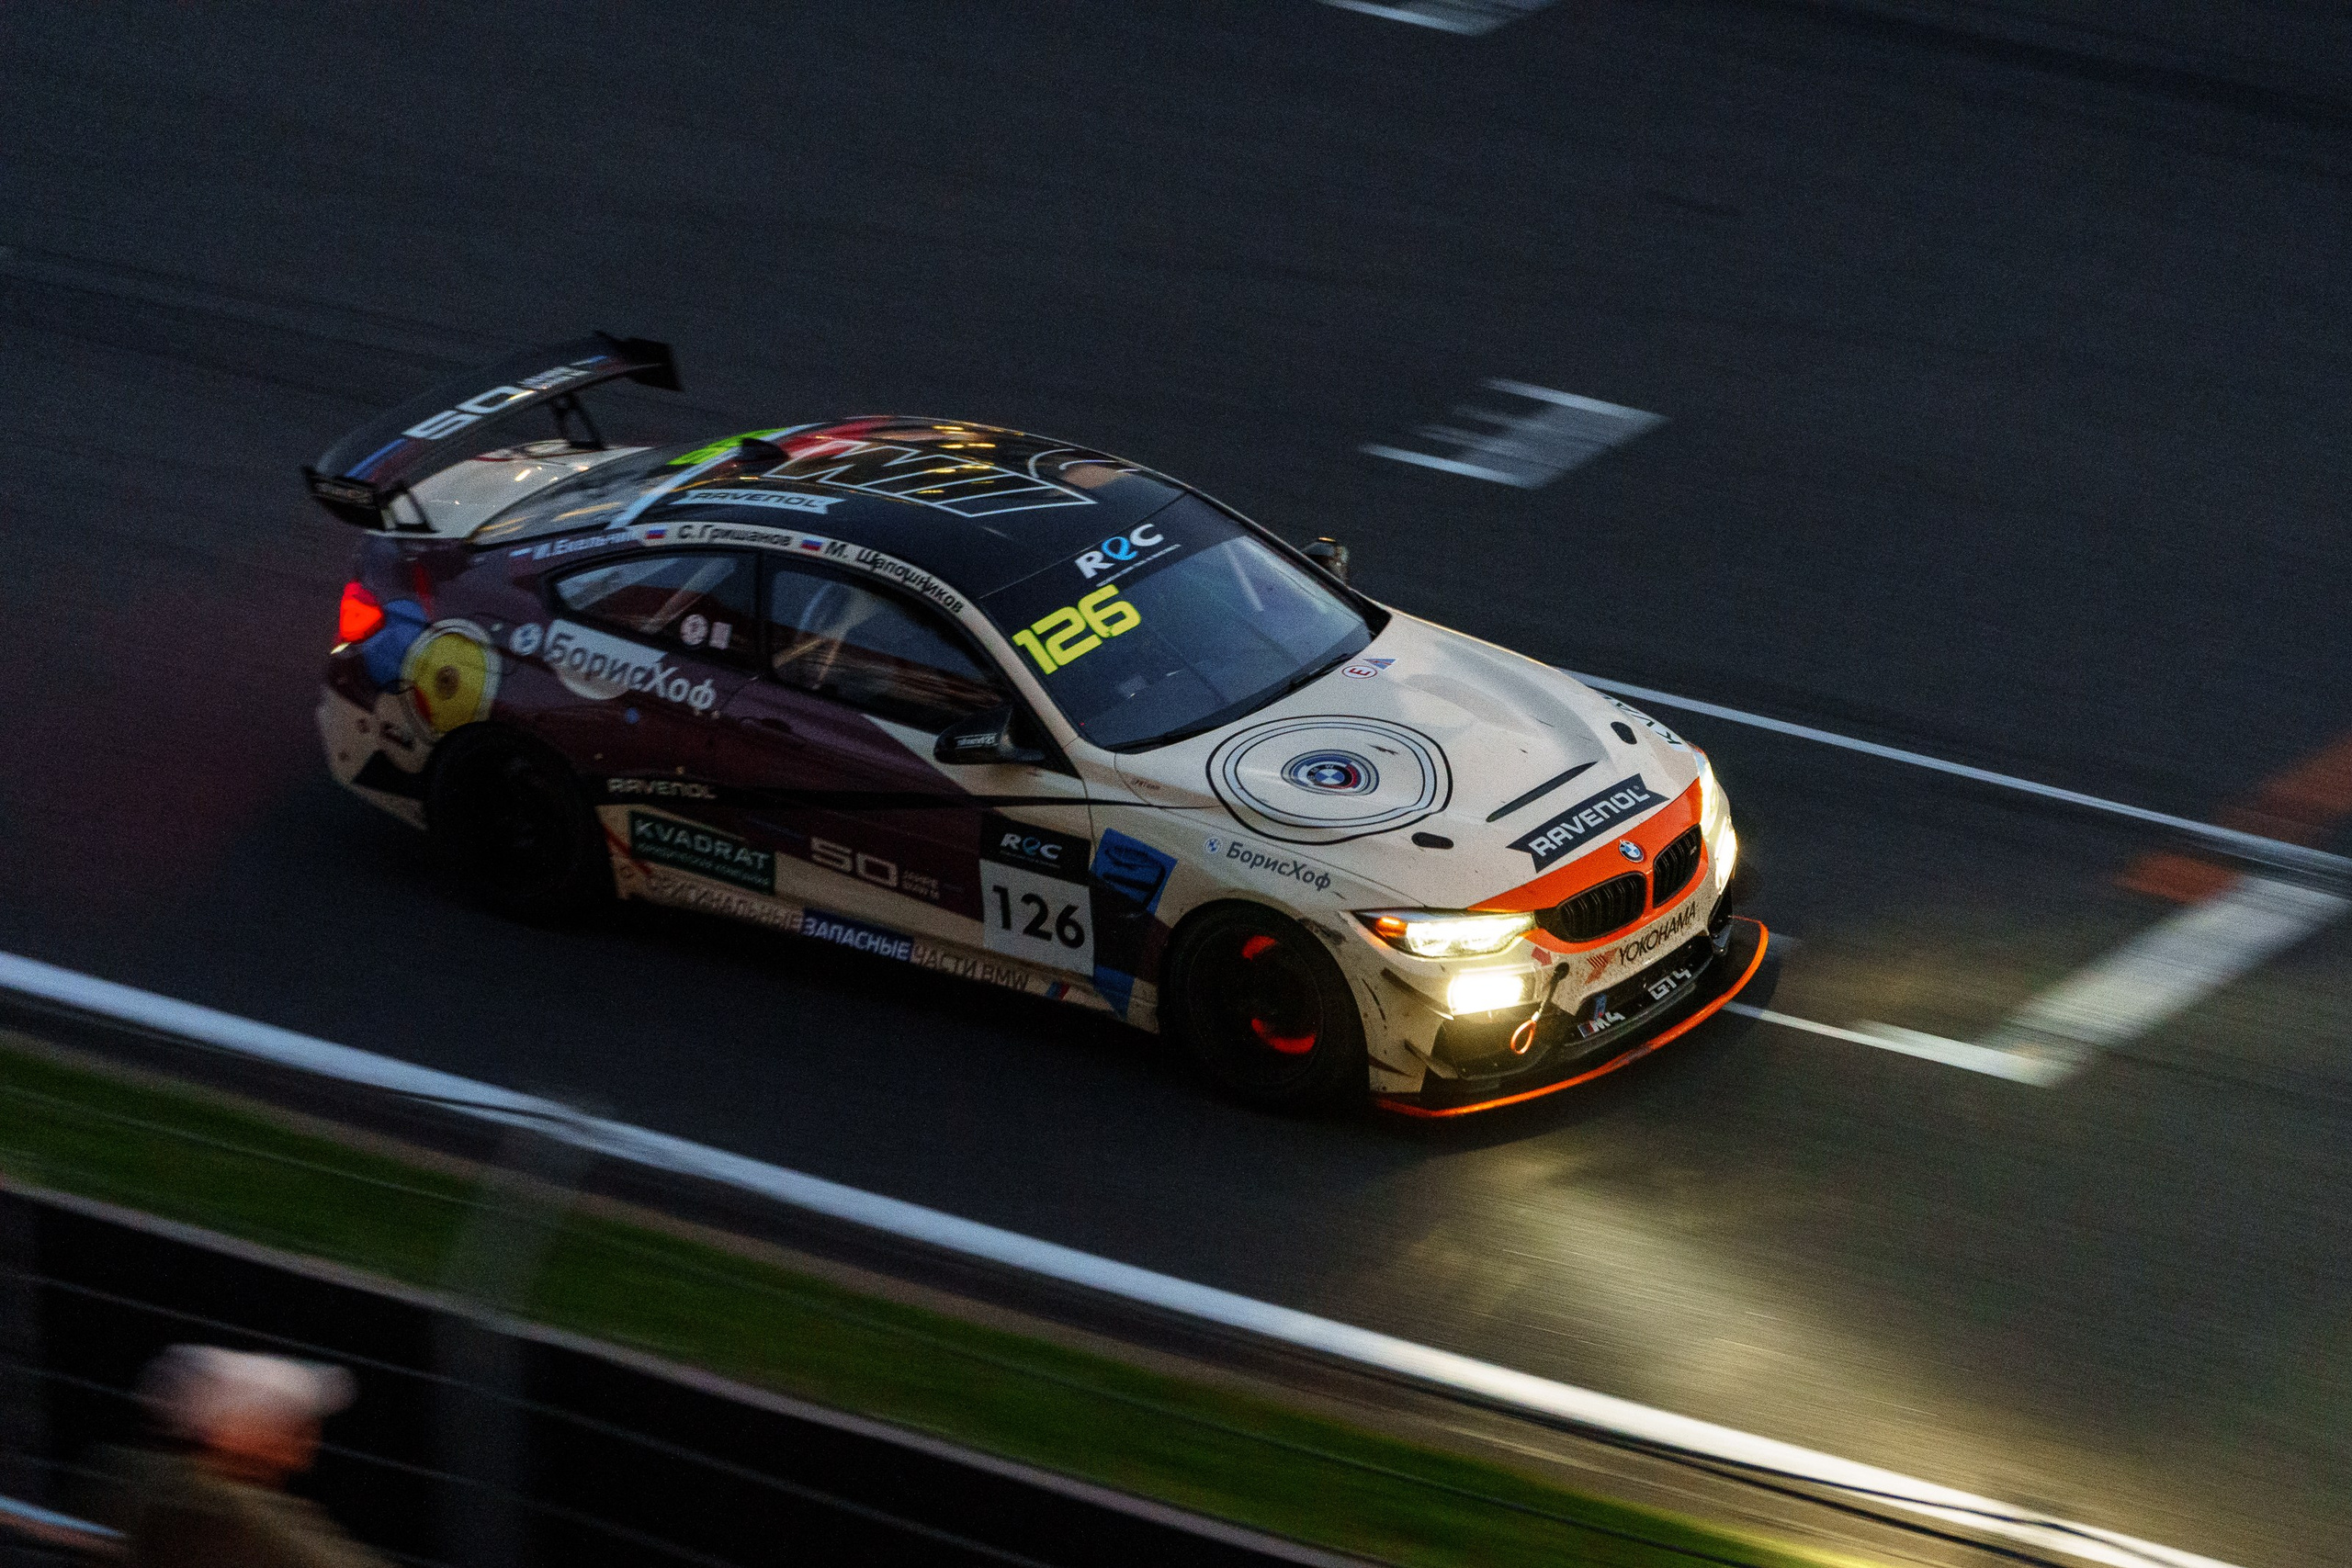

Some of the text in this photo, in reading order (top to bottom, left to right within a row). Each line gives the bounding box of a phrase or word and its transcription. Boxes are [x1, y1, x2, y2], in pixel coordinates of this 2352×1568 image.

[692, 491, 820, 509] RAVENOL
[1012, 583, 1142, 675] 126
[548, 631, 717, 711] БорисХоф
[634, 819, 771, 870] KVADRAT
[1528, 787, 1651, 856] RAVENOL
[810, 836, 899, 888] 50
[1226, 840, 1331, 893] БорисХоф
[802, 916, 912, 963] ЗАПАСНЫЕ
[992, 885, 1086, 949] 126
[1618, 900, 1697, 966] YOKOHAMA
[1647, 966, 1691, 1001] GT4
